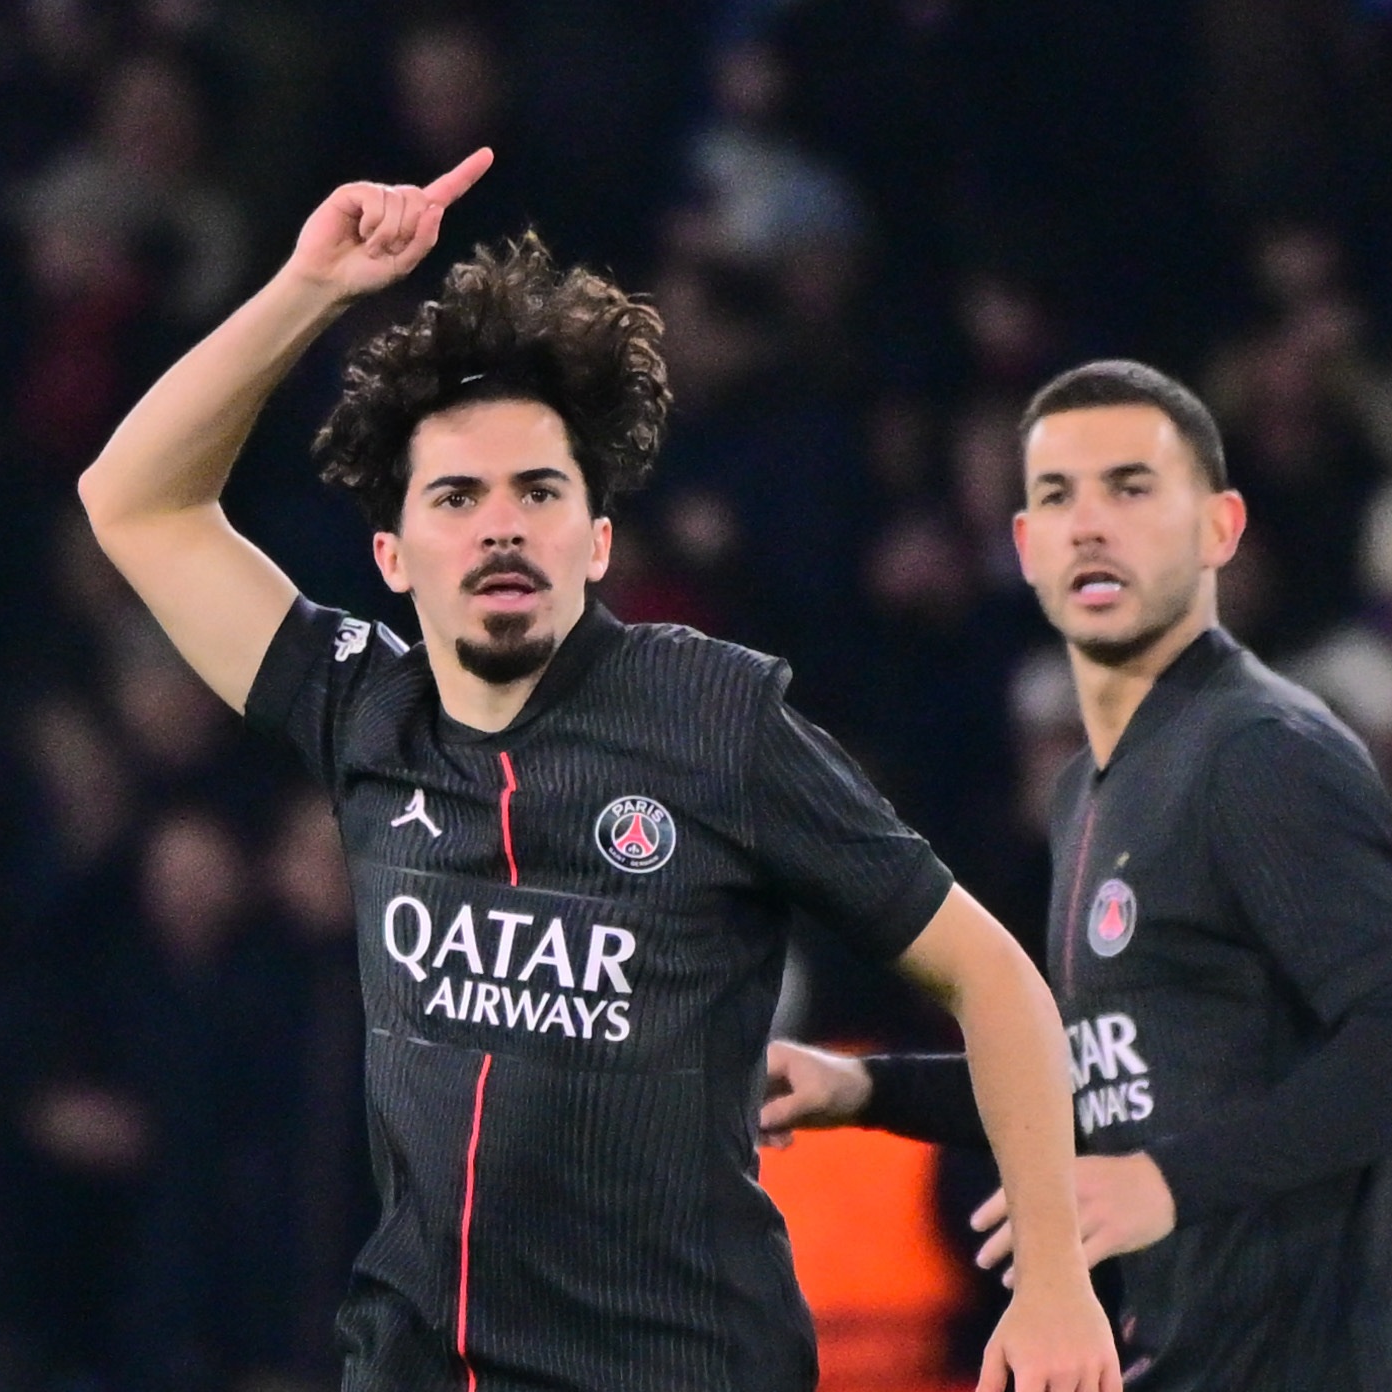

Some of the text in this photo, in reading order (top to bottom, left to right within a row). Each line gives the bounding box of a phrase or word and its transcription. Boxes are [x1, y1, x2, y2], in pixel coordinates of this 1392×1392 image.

[611, 800, 665, 823] PARIS
[384, 895, 637, 994] QATAR
[424, 976, 631, 1042] AIRWAYS
